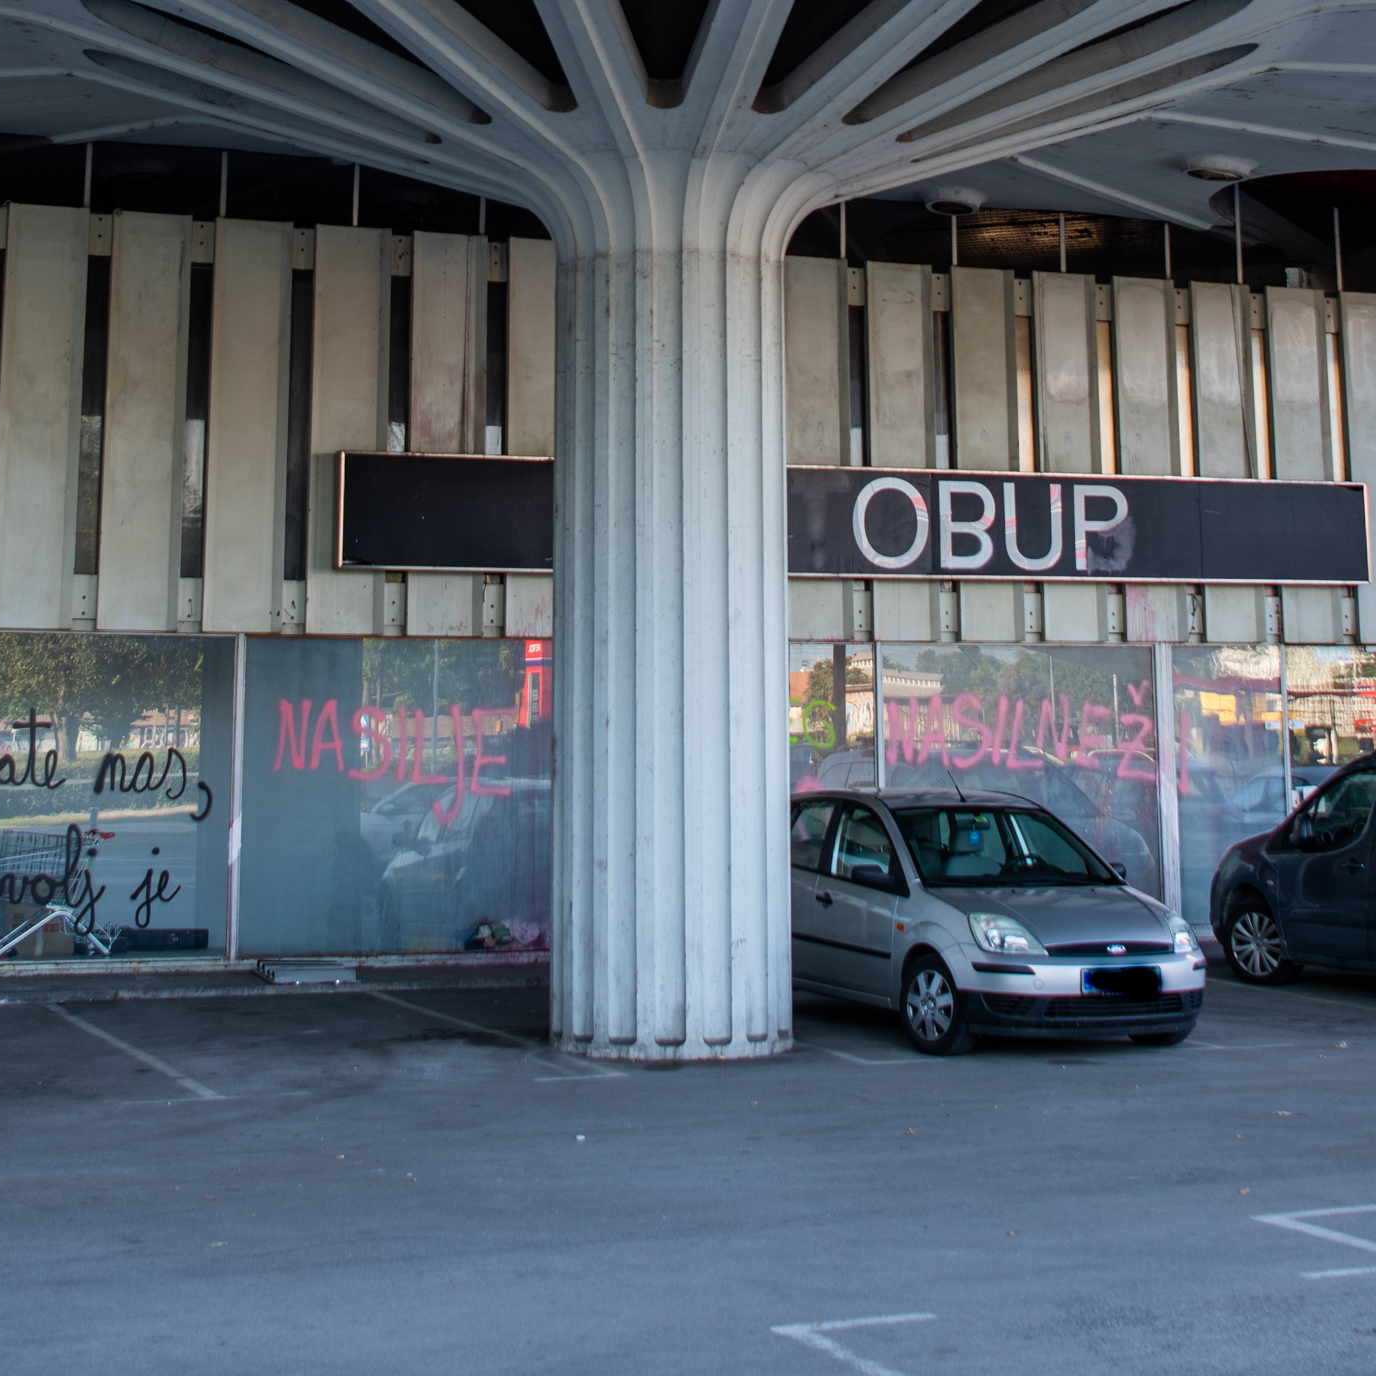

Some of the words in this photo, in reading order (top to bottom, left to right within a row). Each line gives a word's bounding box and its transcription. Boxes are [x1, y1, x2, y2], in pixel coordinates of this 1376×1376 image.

[852, 476, 1129, 572] OBUP
[273, 699, 518, 824] NASILJE
[130, 846, 182, 928] je
